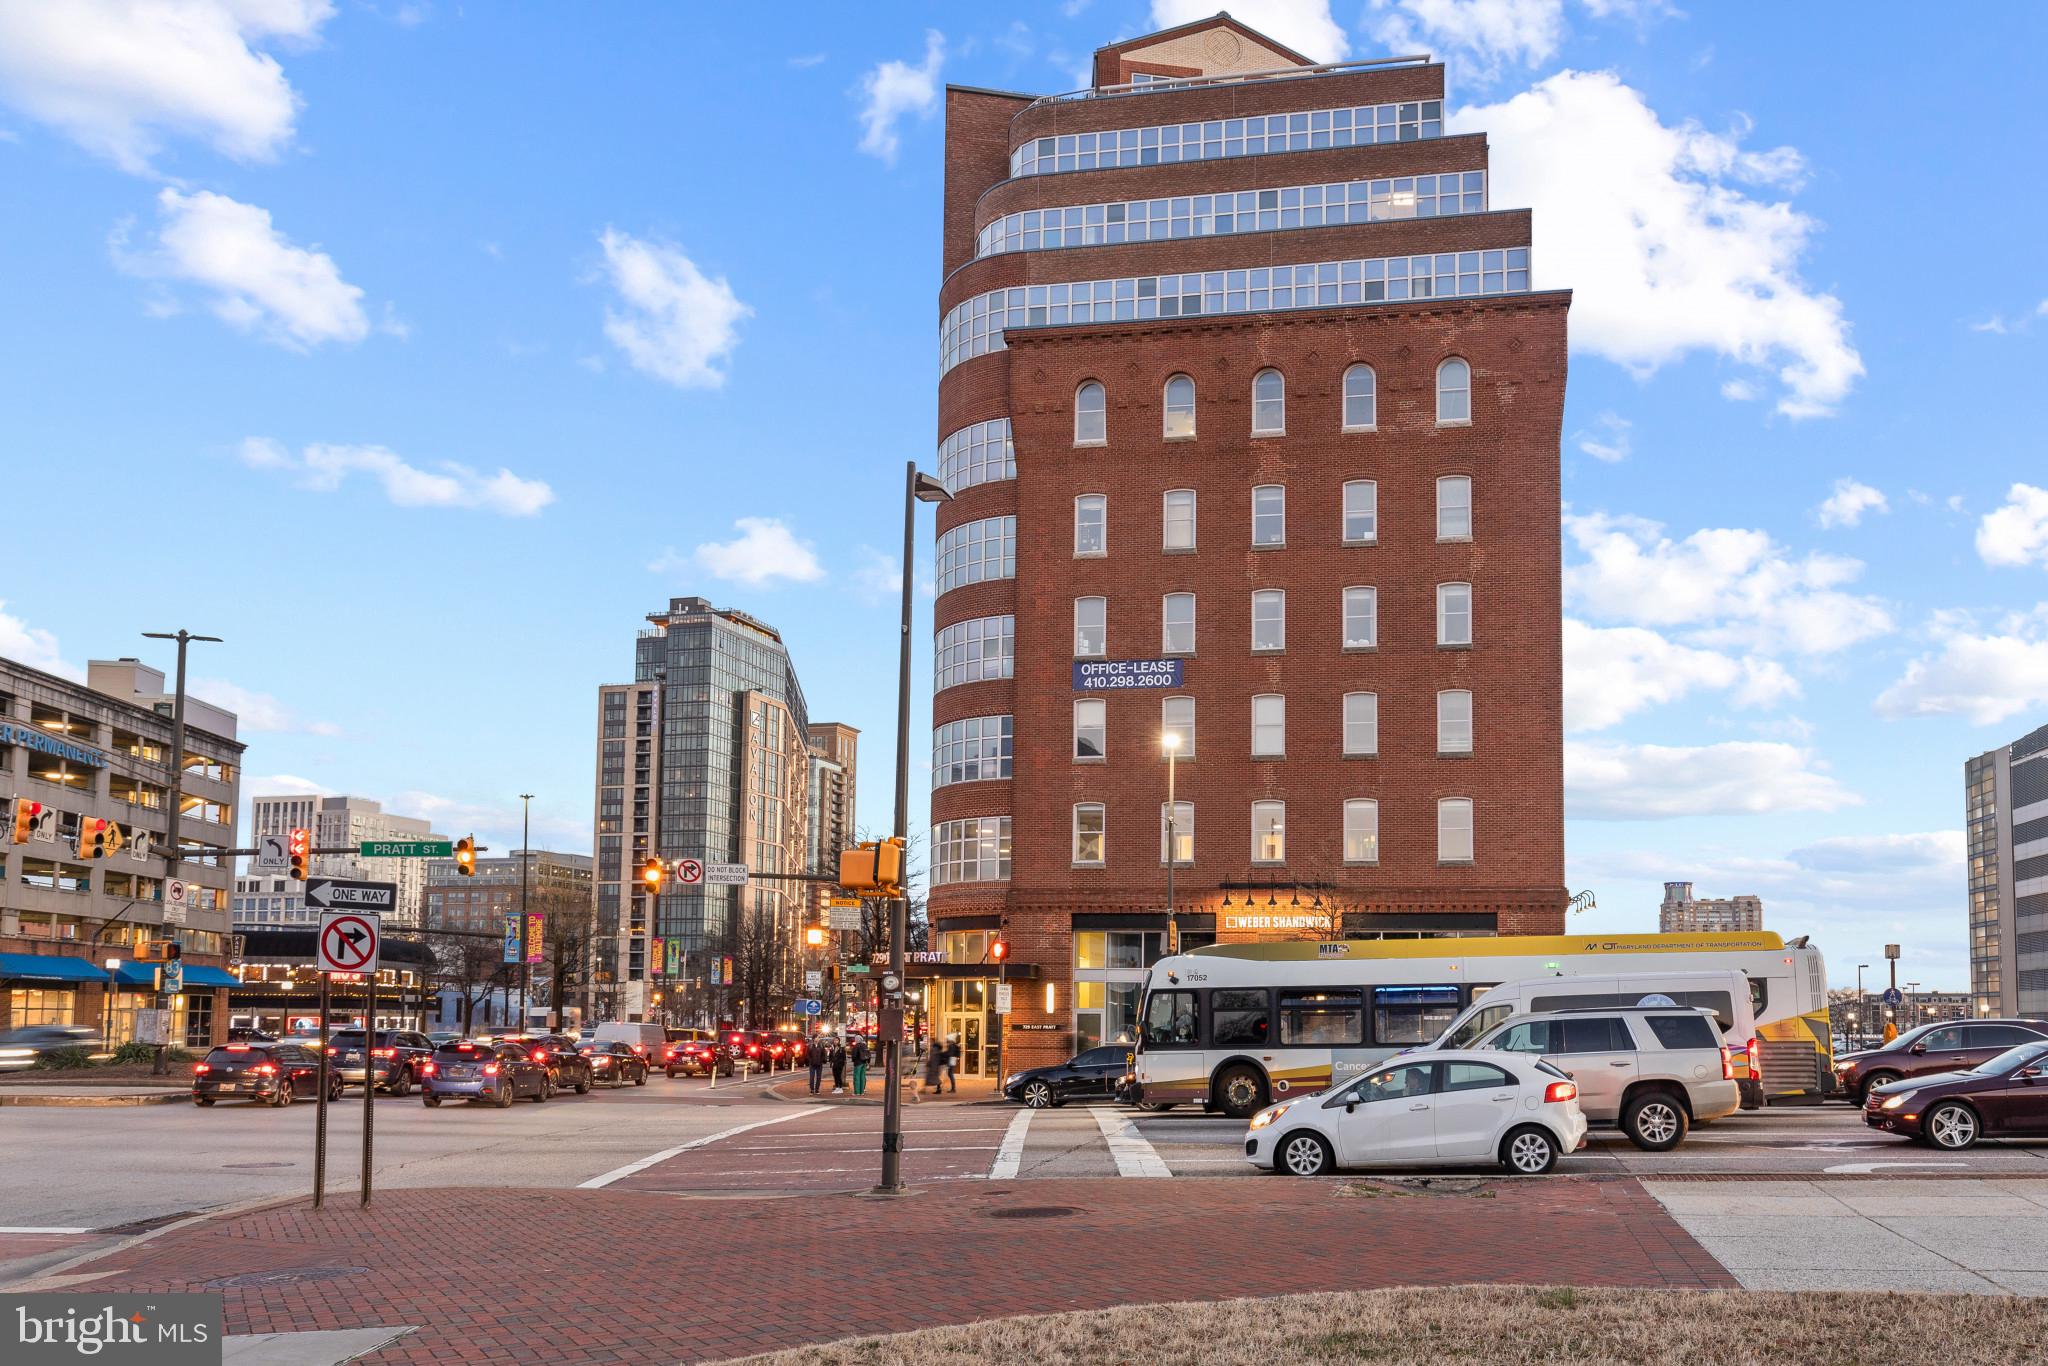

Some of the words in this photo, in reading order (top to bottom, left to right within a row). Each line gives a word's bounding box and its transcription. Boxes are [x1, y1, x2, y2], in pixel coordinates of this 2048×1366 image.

[1081, 661, 1175, 675] OFFICE-LEASE
[1084, 674, 1172, 688] 410.298.2600
[36, 830, 52, 839] ONLY
[373, 844, 416, 854] PRATT
[423, 845, 439, 854] ST.
[132, 851, 146, 860] ONLY
[263, 857, 285, 865] ONLY
[332, 888, 357, 901] ONE
[361, 890, 387, 902] WAY
[528, 915, 535, 924] TO
[1238, 916, 1270, 928] WEBER
[1273, 916, 1331, 928] SHANDWICK
[535, 919, 543, 954] BALTIMORE
[1320, 944, 1338, 953] MTA
[166, 961, 180, 975] 83
